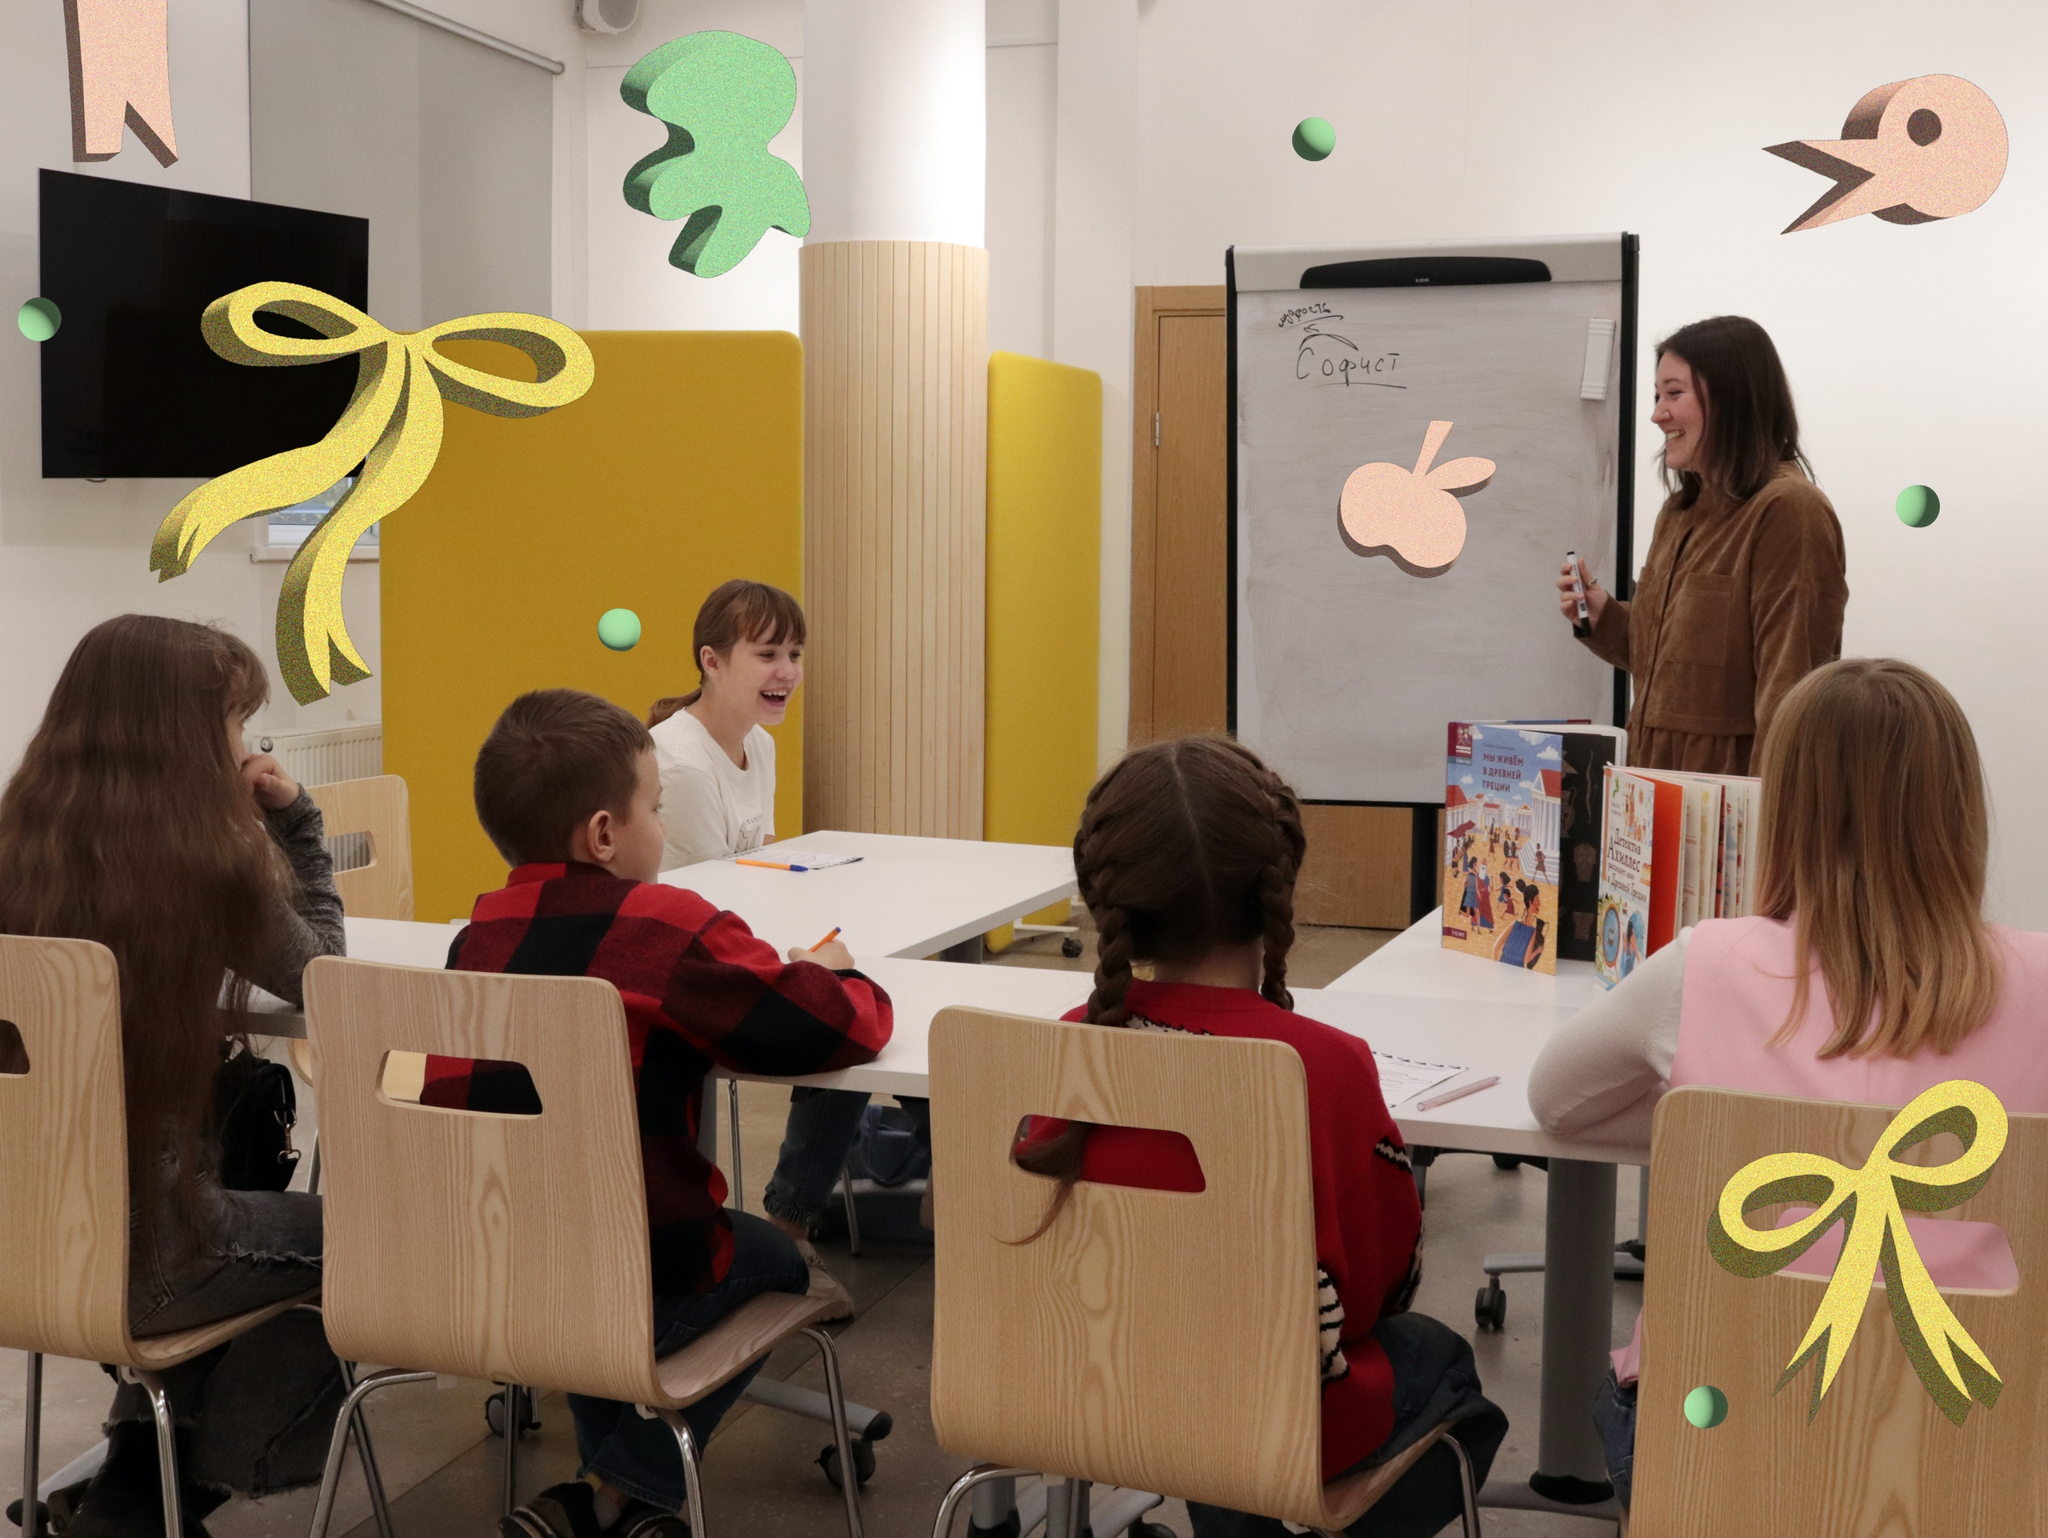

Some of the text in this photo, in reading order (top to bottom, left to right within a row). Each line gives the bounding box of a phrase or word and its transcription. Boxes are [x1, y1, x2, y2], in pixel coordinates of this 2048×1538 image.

[1296, 347, 1400, 387] Софист
[1483, 753, 1495, 762] МЫ
[1496, 754, 1524, 766] ЖИВЁМ
[1483, 766, 1522, 780] В ДРЕВНЕЙ
[1482, 780, 1511, 792] ГРЕЦИИ
[1614, 827, 1642, 856] Детектив
[1607, 834, 1641, 873] Ахиллес
